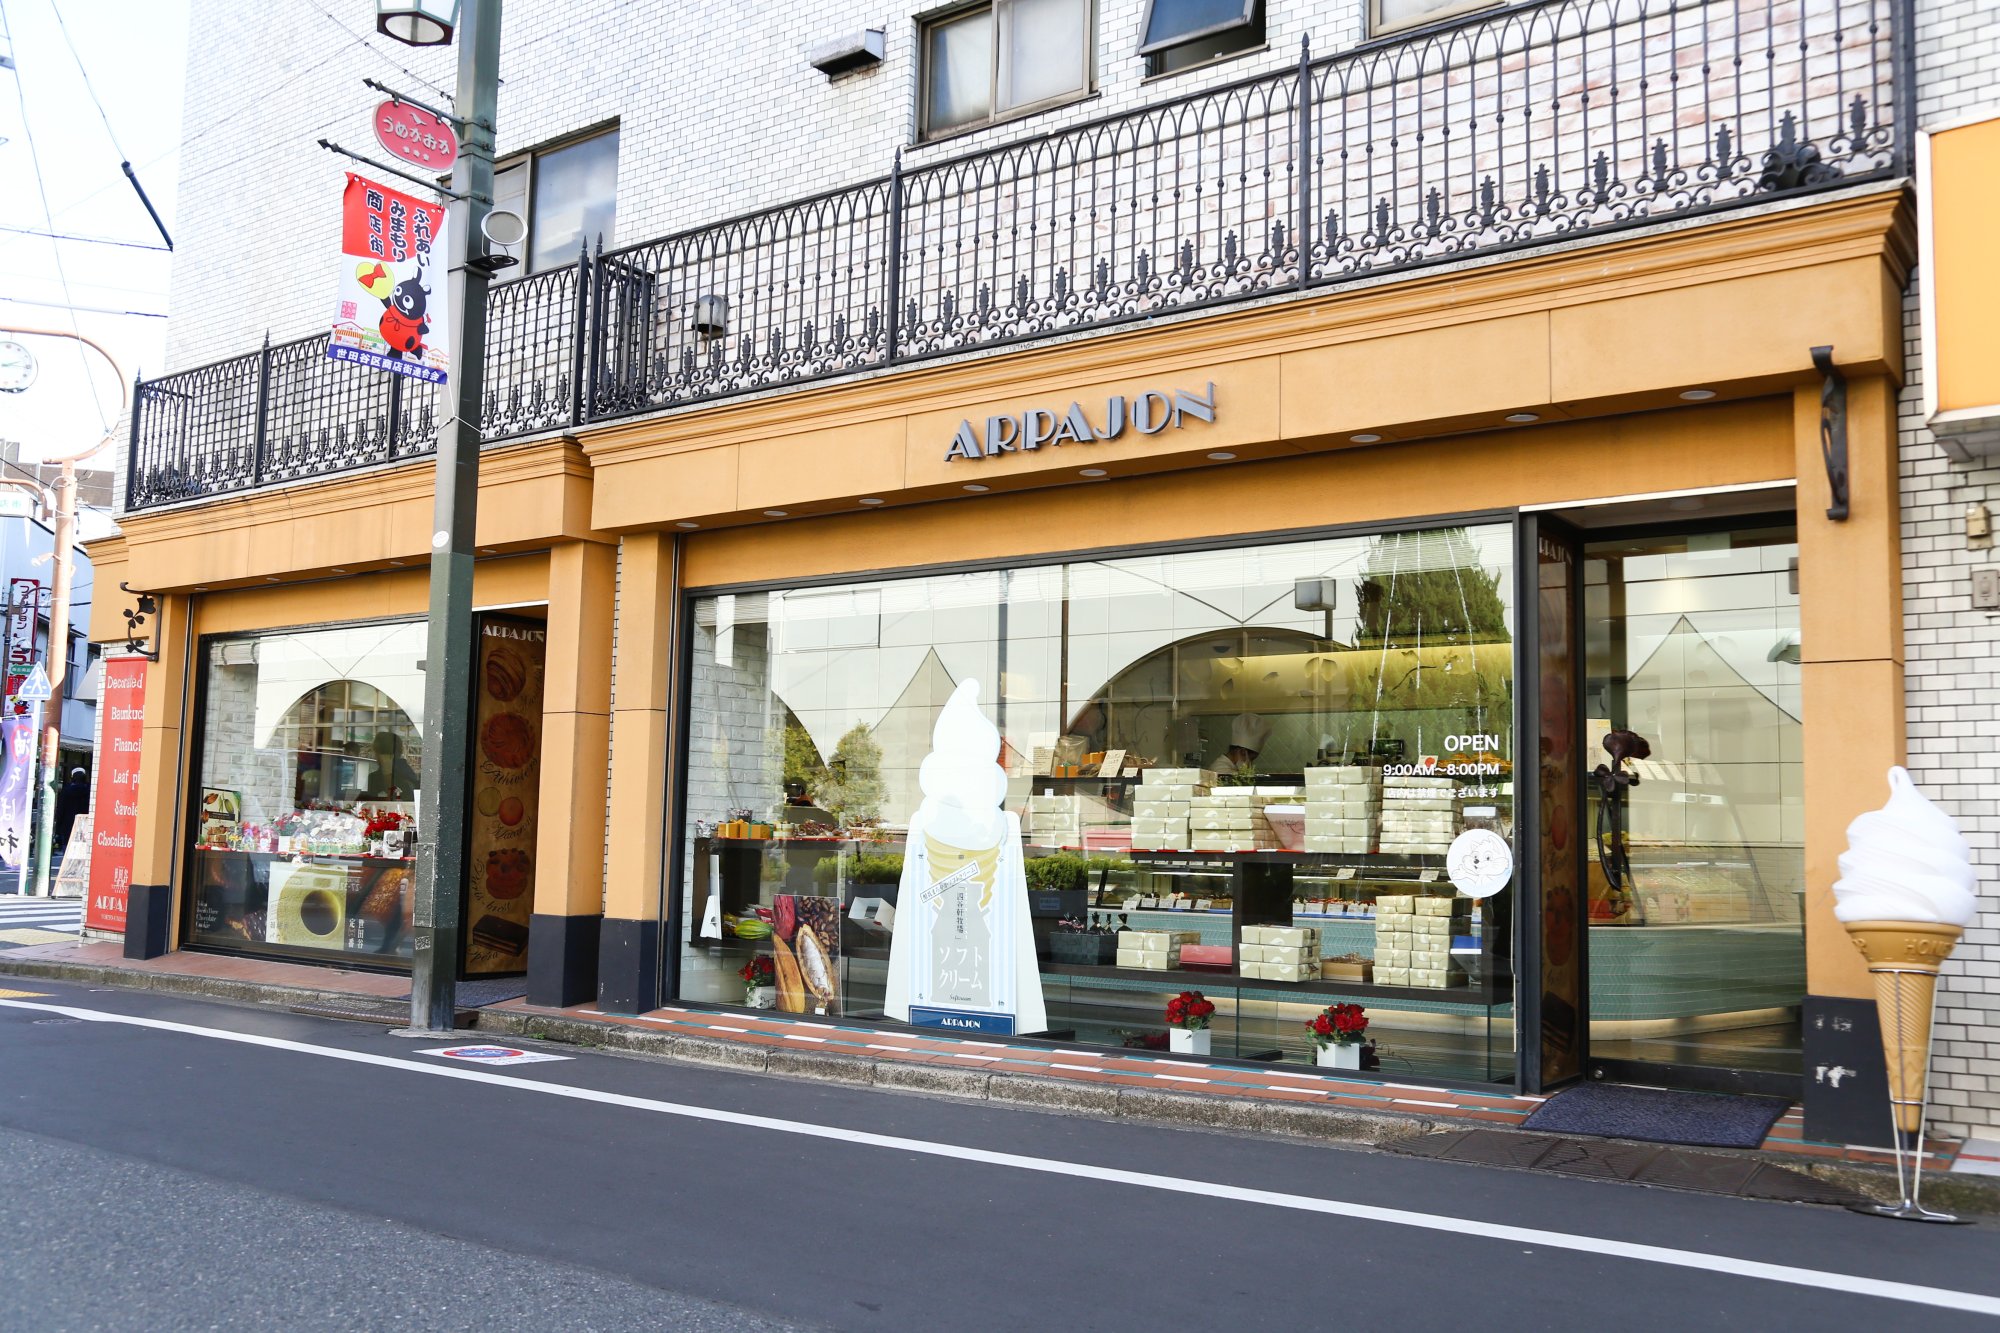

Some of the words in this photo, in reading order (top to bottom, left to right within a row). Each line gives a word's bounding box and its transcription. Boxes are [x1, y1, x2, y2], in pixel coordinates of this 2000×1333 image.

[367, 189, 383, 256] 商店街
[390, 200, 407, 262] みまもり
[414, 208, 430, 267] ふれあい
[336, 348, 440, 381] 世田谷区商店街連合会
[944, 381, 1216, 462] ARPAJON
[482, 624, 545, 642] ARPAJON
[1444, 734, 1499, 751] OPEN
[113, 769, 129, 784] Leaf
[97, 830, 133, 848] Chocolate
[940, 946, 982, 967] ソフト
[939, 969, 982, 990] クリーム
[941, 1017, 981, 1029] ARPAJON
